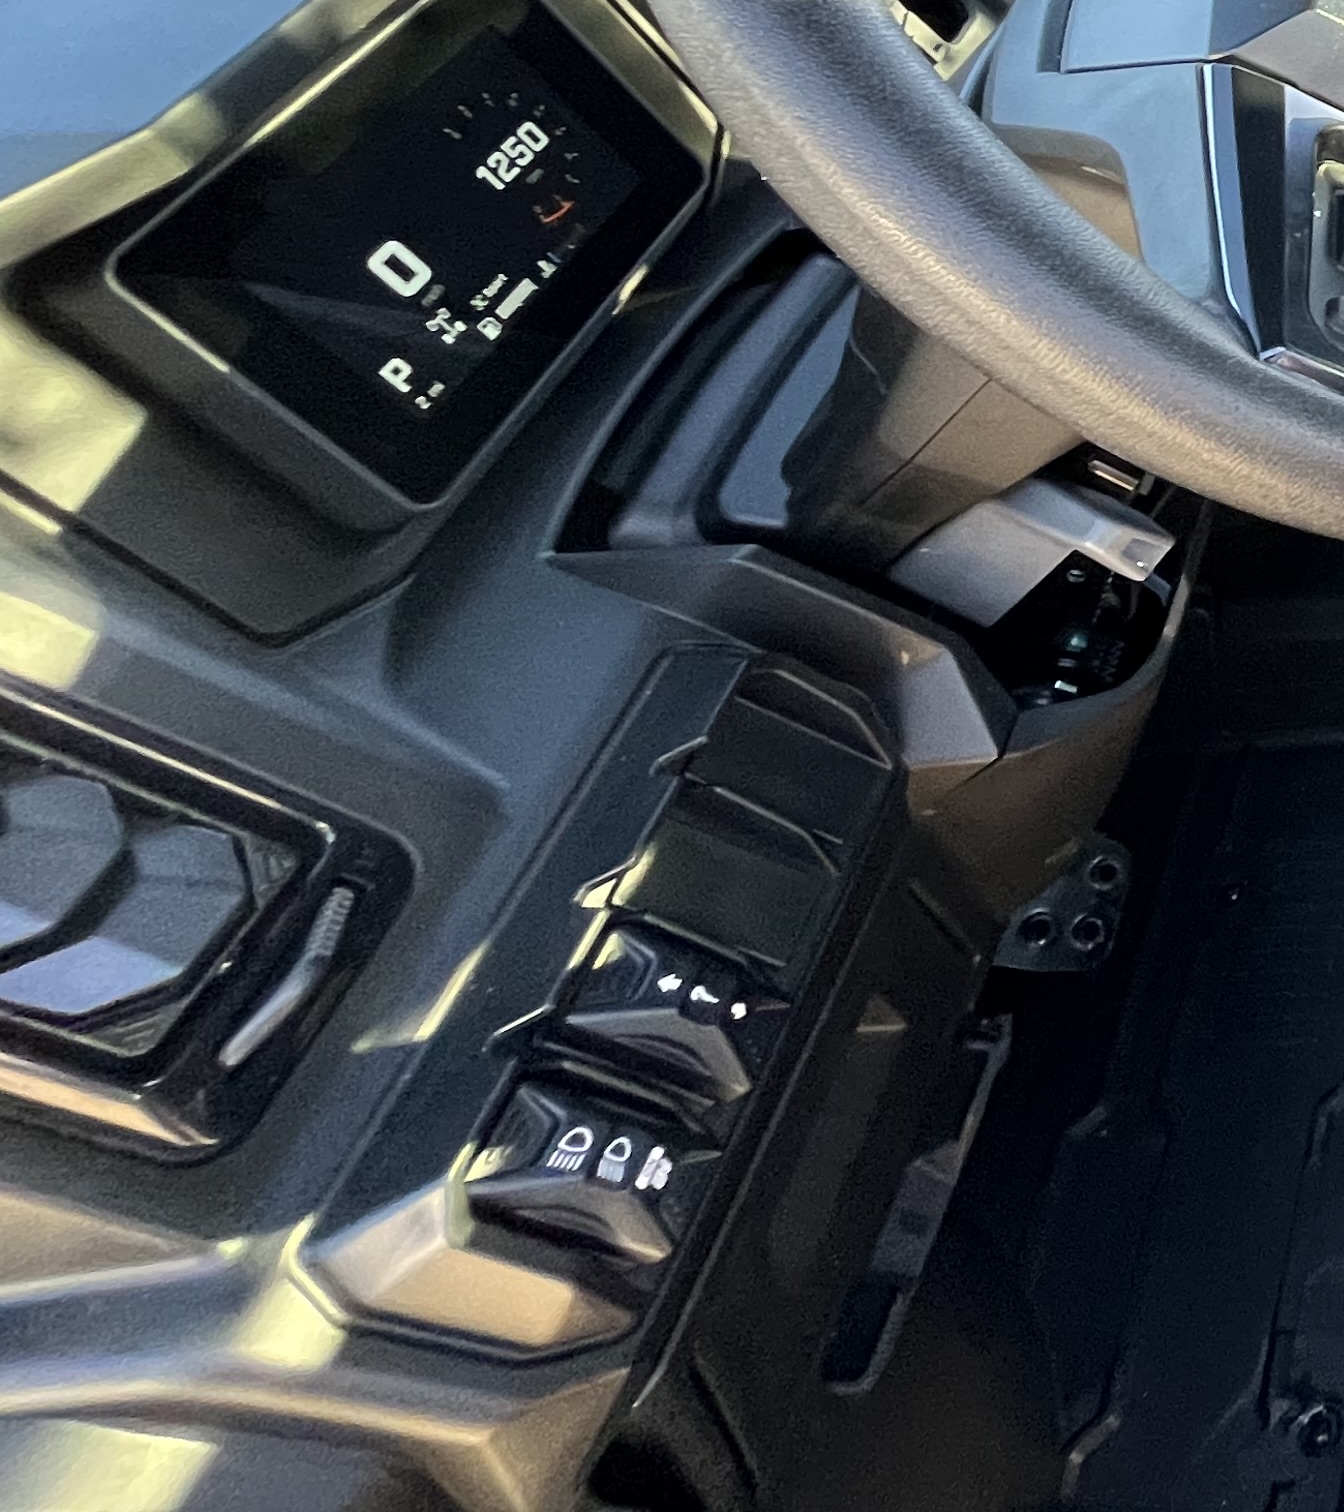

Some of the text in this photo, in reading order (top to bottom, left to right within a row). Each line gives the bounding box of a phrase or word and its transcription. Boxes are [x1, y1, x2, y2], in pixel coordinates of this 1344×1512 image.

[475, 121, 549, 190] 1250
[366, 240, 432, 298] 0
[378, 357, 413, 393] P
